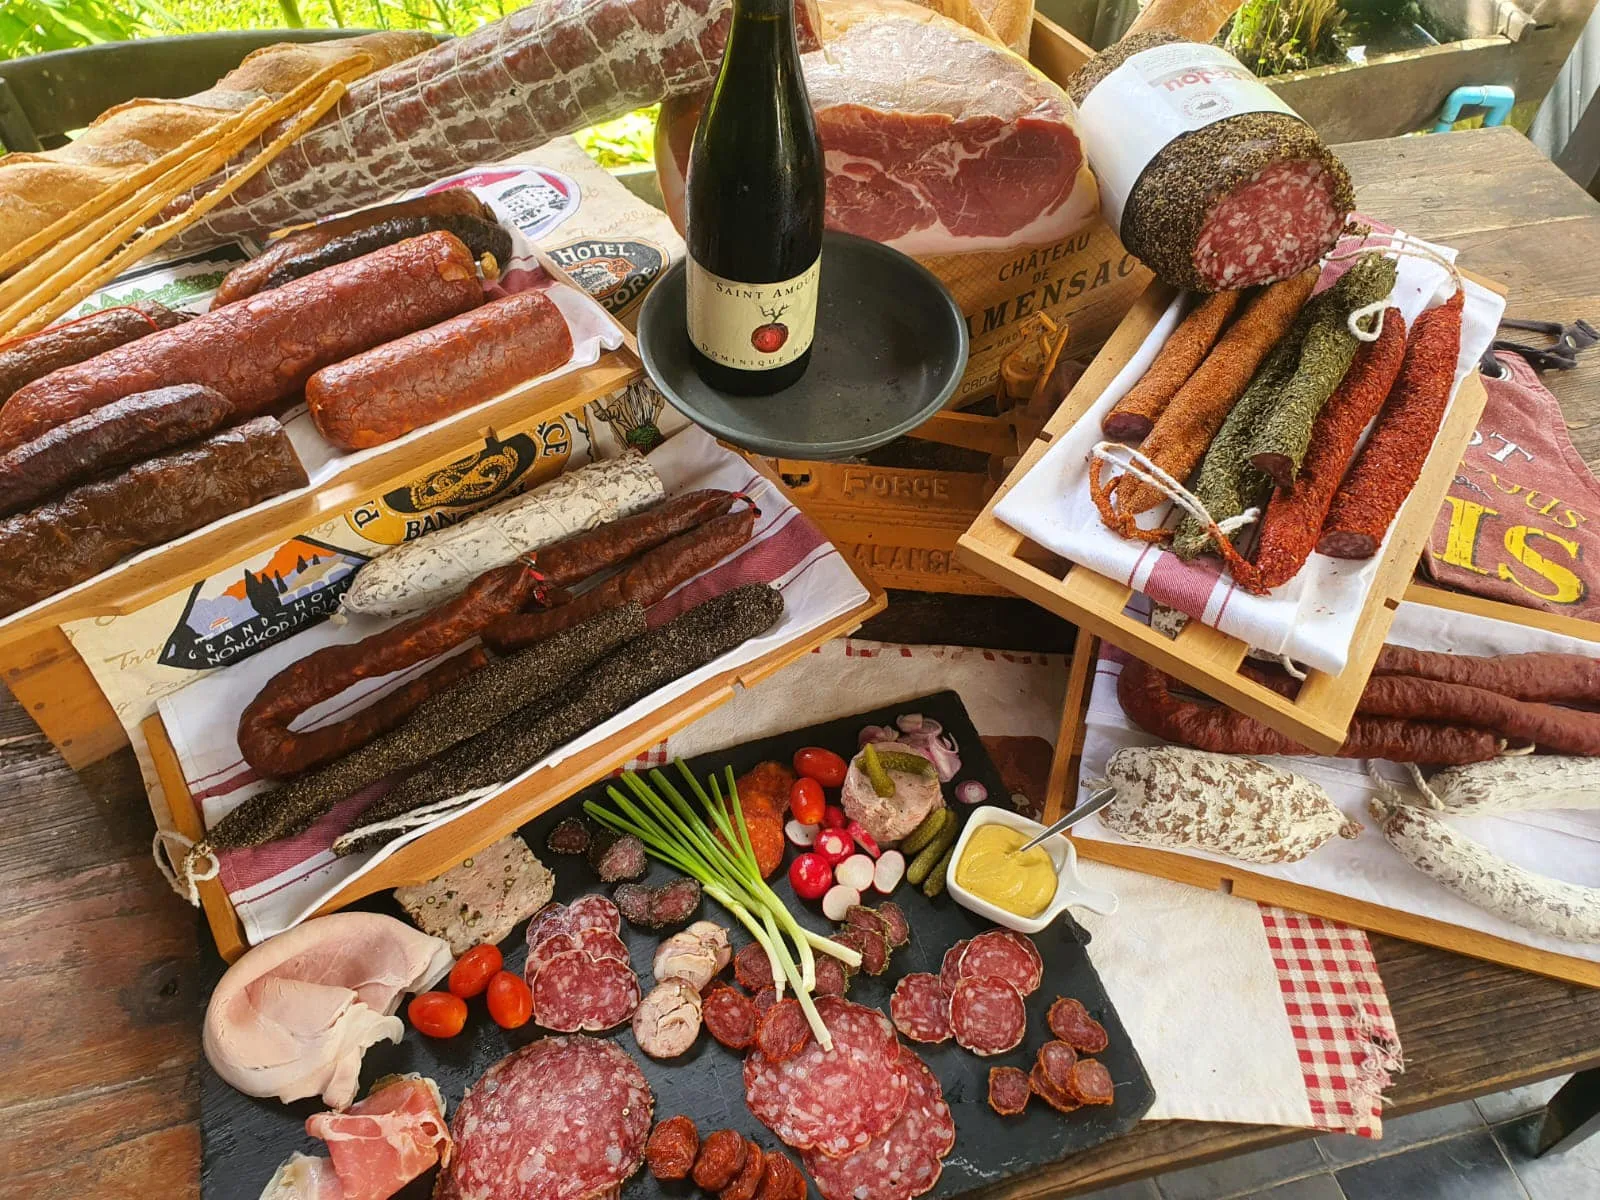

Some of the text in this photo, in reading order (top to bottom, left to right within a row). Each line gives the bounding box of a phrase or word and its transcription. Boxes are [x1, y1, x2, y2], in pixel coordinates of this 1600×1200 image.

[998, 231, 1092, 281] CHÂTEAU
[1032, 270, 1049, 285] DE
[715, 282, 764, 300] SAINT
[702, 342, 785, 367] DOMINIQUE
